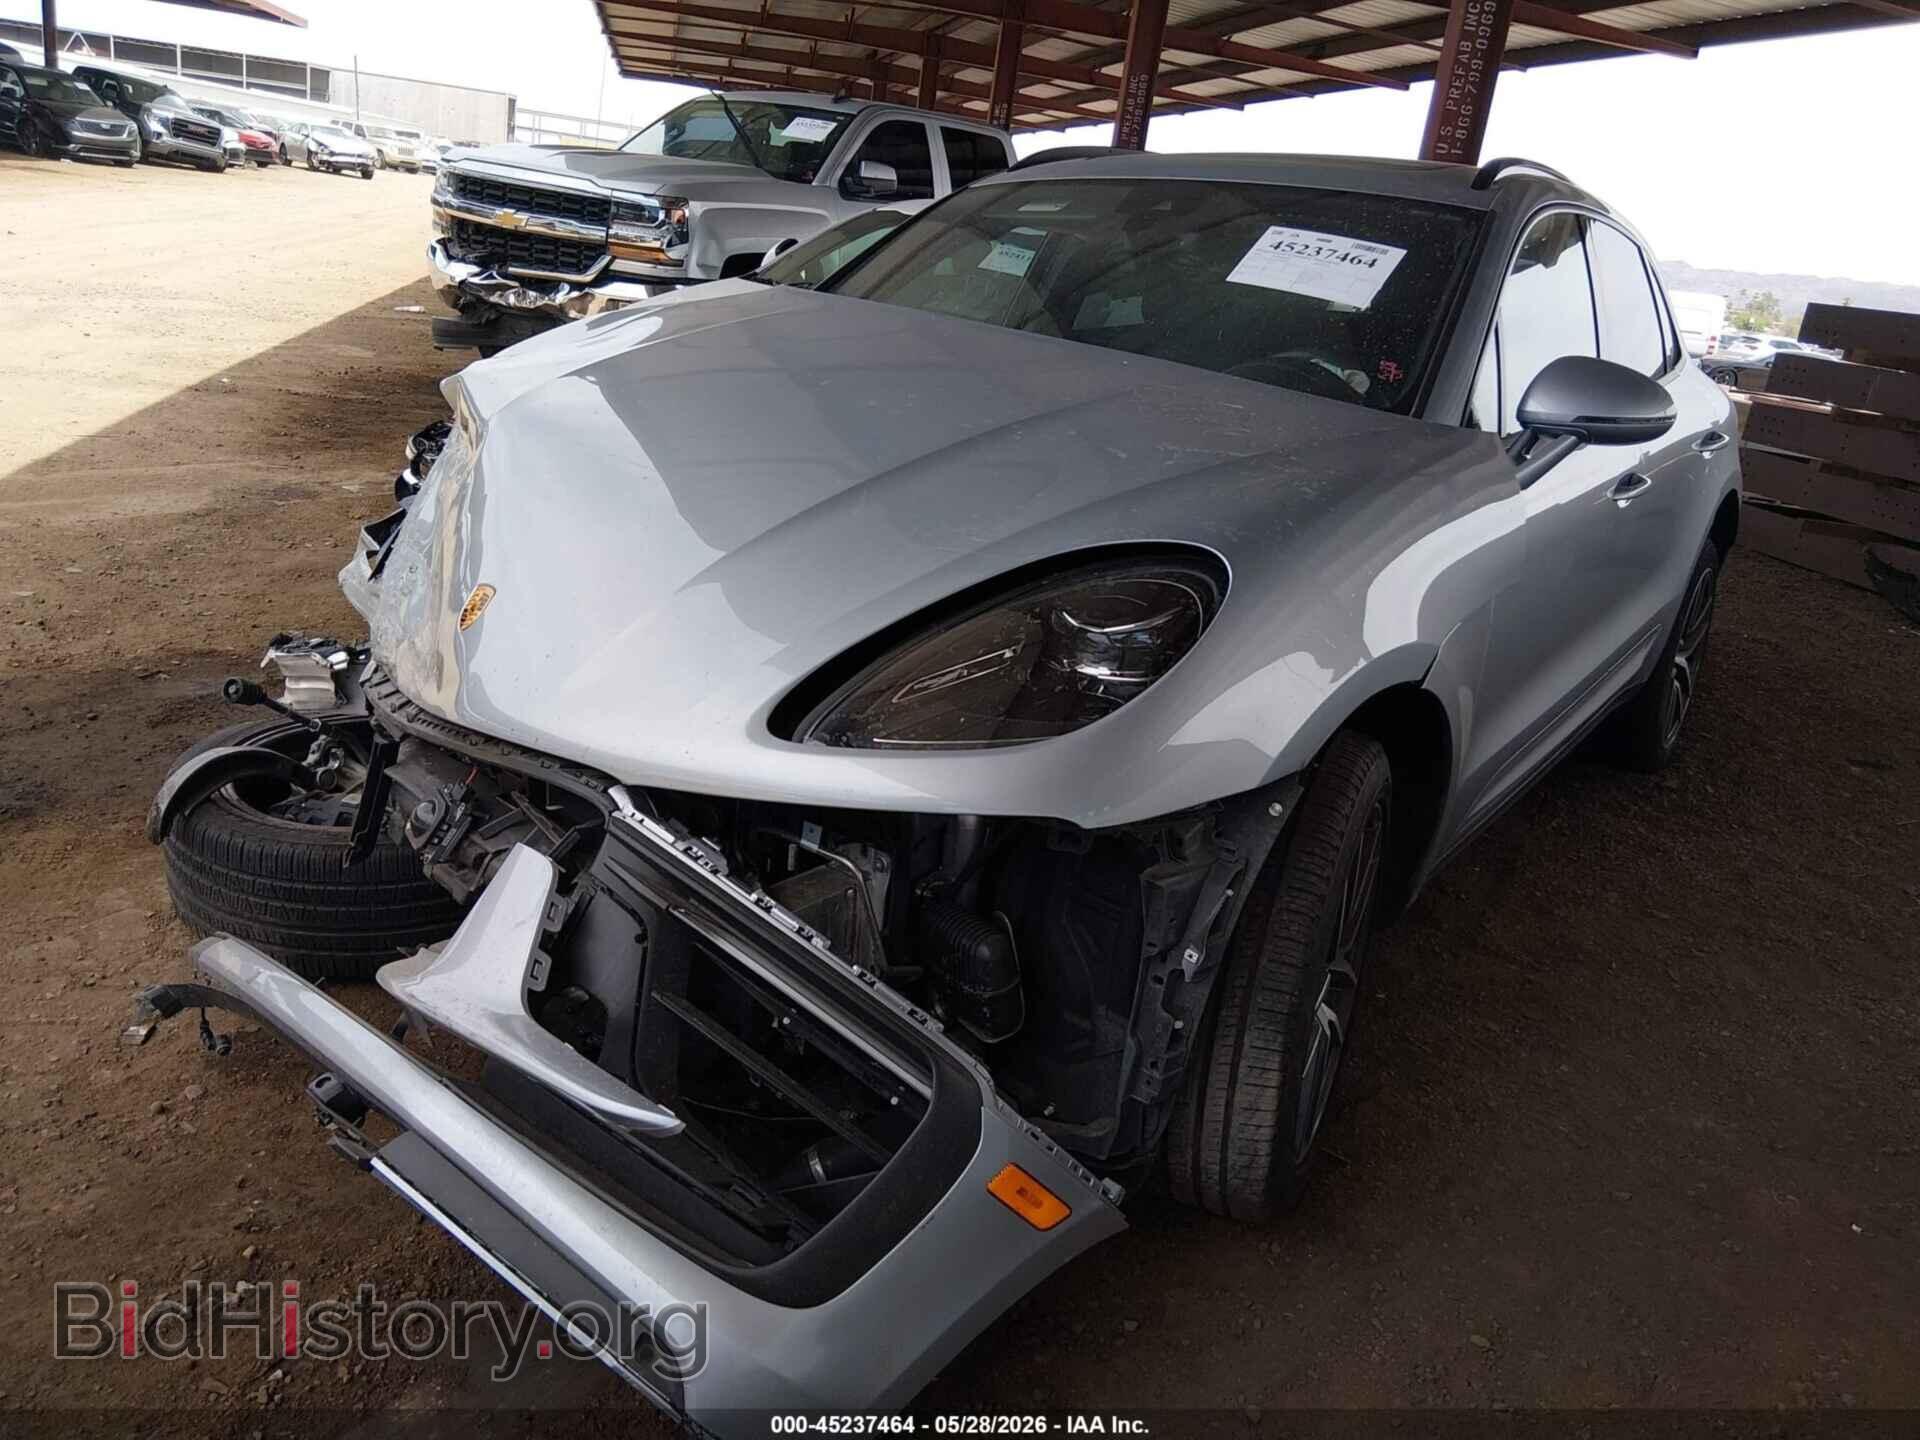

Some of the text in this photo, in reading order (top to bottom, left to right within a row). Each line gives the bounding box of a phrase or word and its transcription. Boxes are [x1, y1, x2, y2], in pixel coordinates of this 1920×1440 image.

[1446, 41, 1472, 111] PREFAB
[1451, 1, 1497, 154] 1-866-799-0969
[1269, 240, 1379, 268] 45237464
